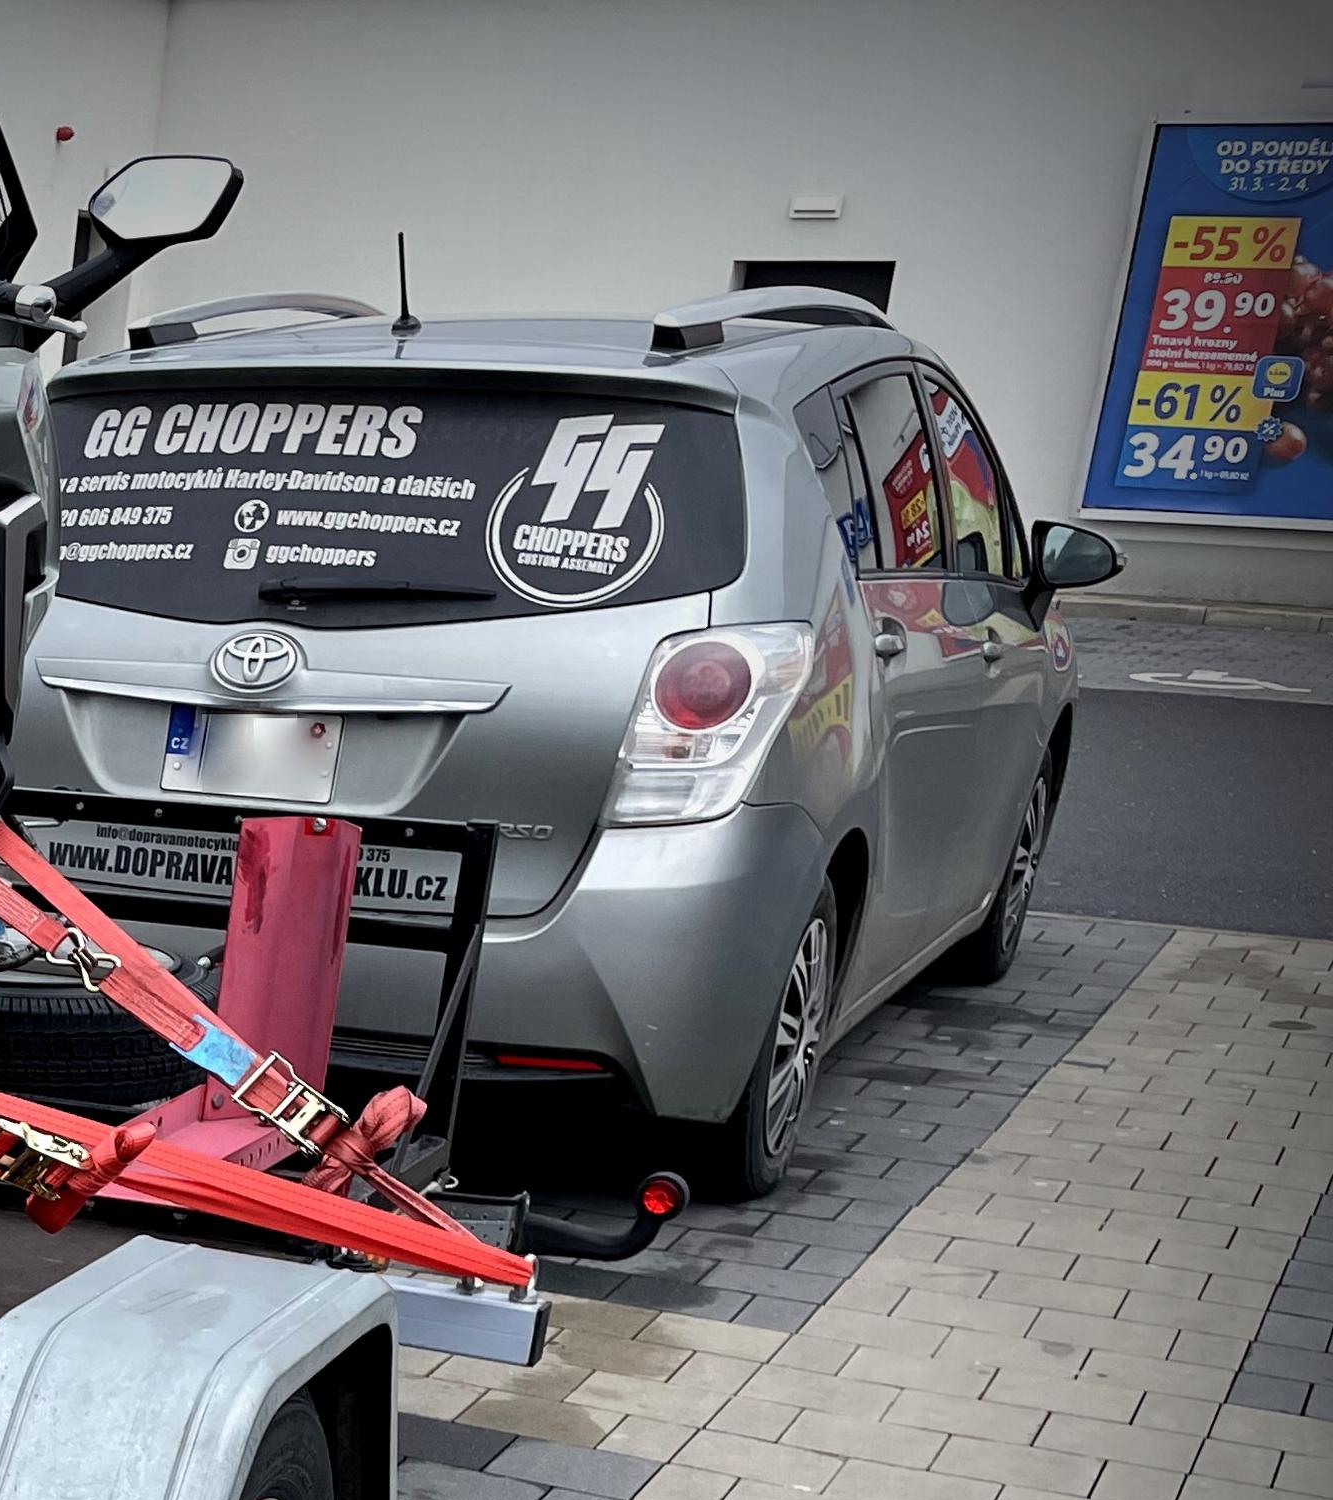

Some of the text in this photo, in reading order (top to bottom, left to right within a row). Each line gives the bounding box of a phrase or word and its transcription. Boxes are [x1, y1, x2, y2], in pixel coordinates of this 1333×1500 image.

[1216, 137, 1333, 157] OD PONDĚL
[1221, 156, 1330, 175] DO STŘEDY
[1228, 176, 1248, 192] 31.
[1251, 177, 1264, 192] 3.
[1278, 176, 1293, 192] 2.
[1295, 177, 1310, 193] 4.
[1173, 226, 1243, 262] -55
[1152, 334, 1238, 351] Tmavé hrozny
[1137, 382, 1201, 421] -61
[1263, 386, 1285, 398] Plus
[83, 402, 424, 460] GG CHOPPERS
[66, 476, 81, 494] a
[79, 470, 130, 493] servis
[130, 466, 224, 491] motocyklů
[223, 467, 379, 494] Harley-Davidson
[380, 476, 396, 495] a
[397, 474, 477, 501] dalších
[61, 506, 174, 527] 20 606 849 375
[276, 509, 462, 538] www.ggchoppers.cz
[512, 523, 631, 563] CHOPPERS
[265, 543, 377, 568] ggchoppers
[517, 552, 617, 576] CUSTOM ASSEMBLY
[171, 737, 190, 750] CZ
[498, 822, 554, 841] RSO
[365, 848, 391, 864] 375
